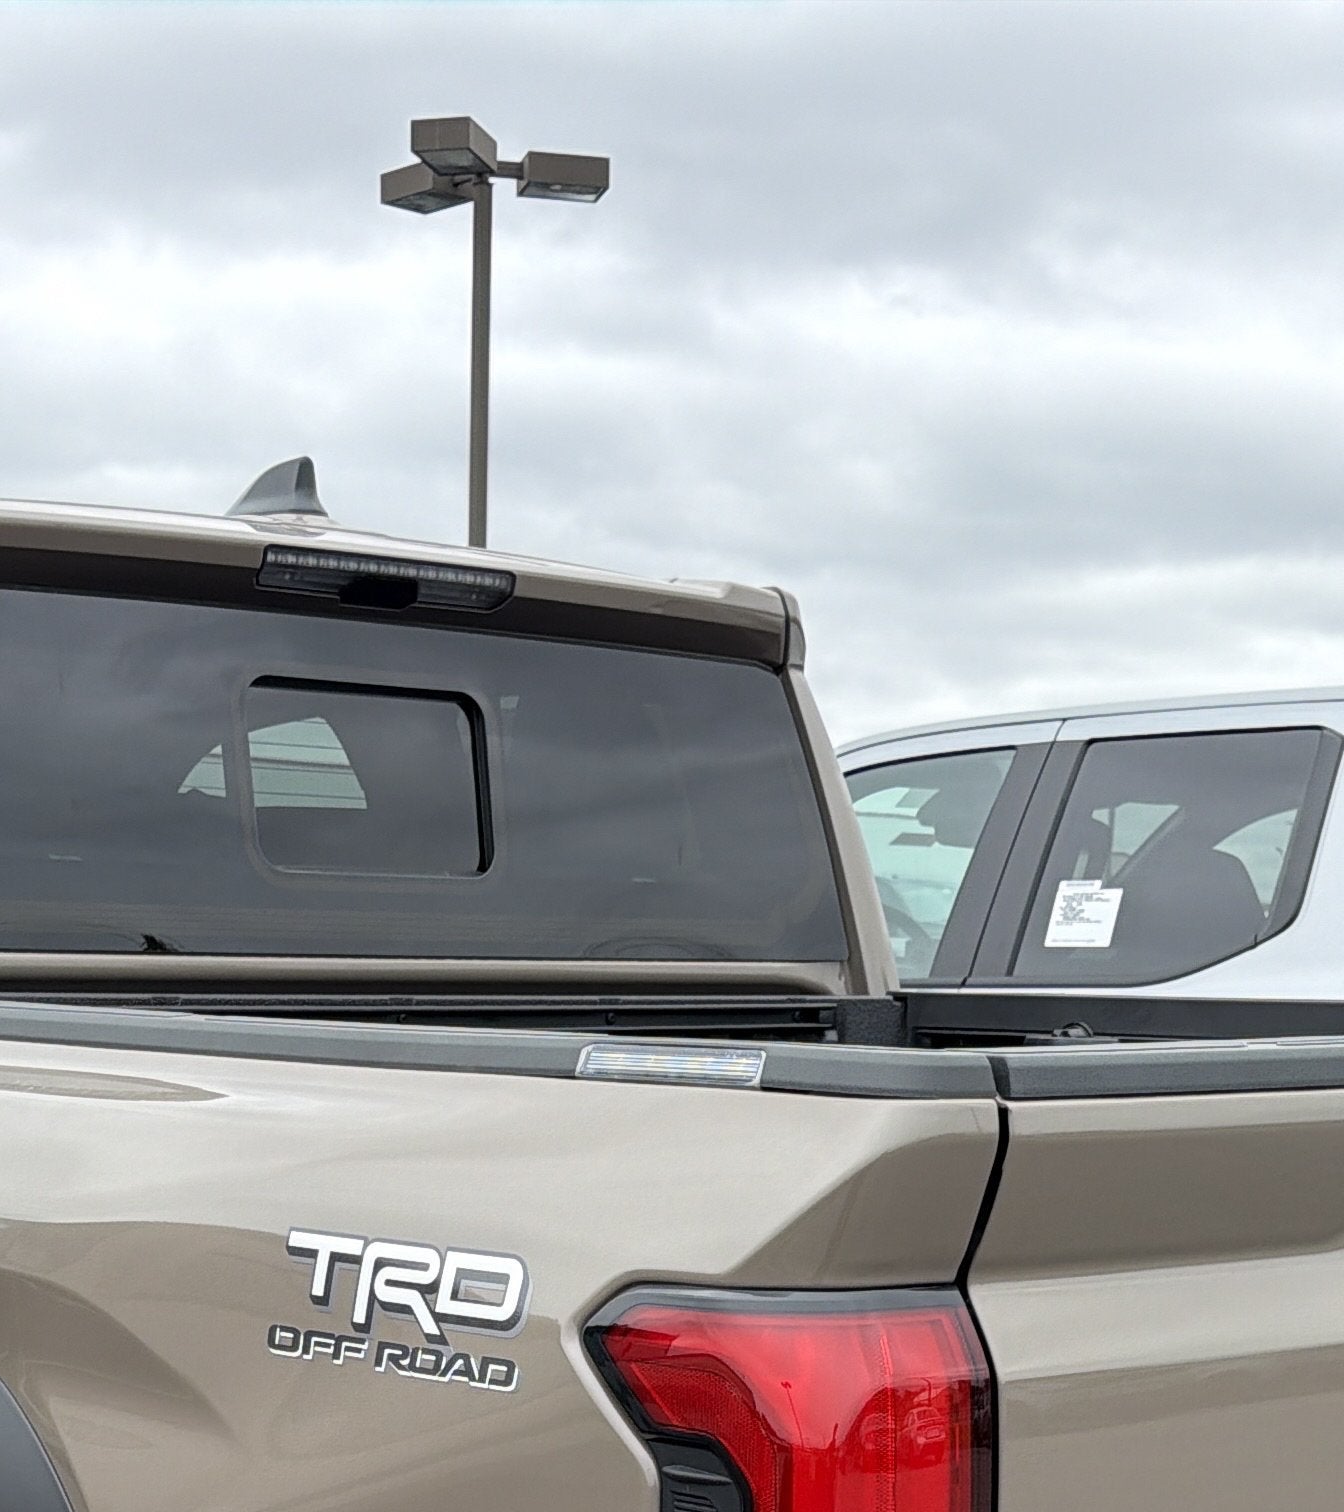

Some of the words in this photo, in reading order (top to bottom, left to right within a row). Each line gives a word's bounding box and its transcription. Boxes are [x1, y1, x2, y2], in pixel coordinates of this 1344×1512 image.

[285, 1227, 532, 1348] TRD
[267, 1324, 368, 1366] OFF
[374, 1340, 520, 1392] ROAD
